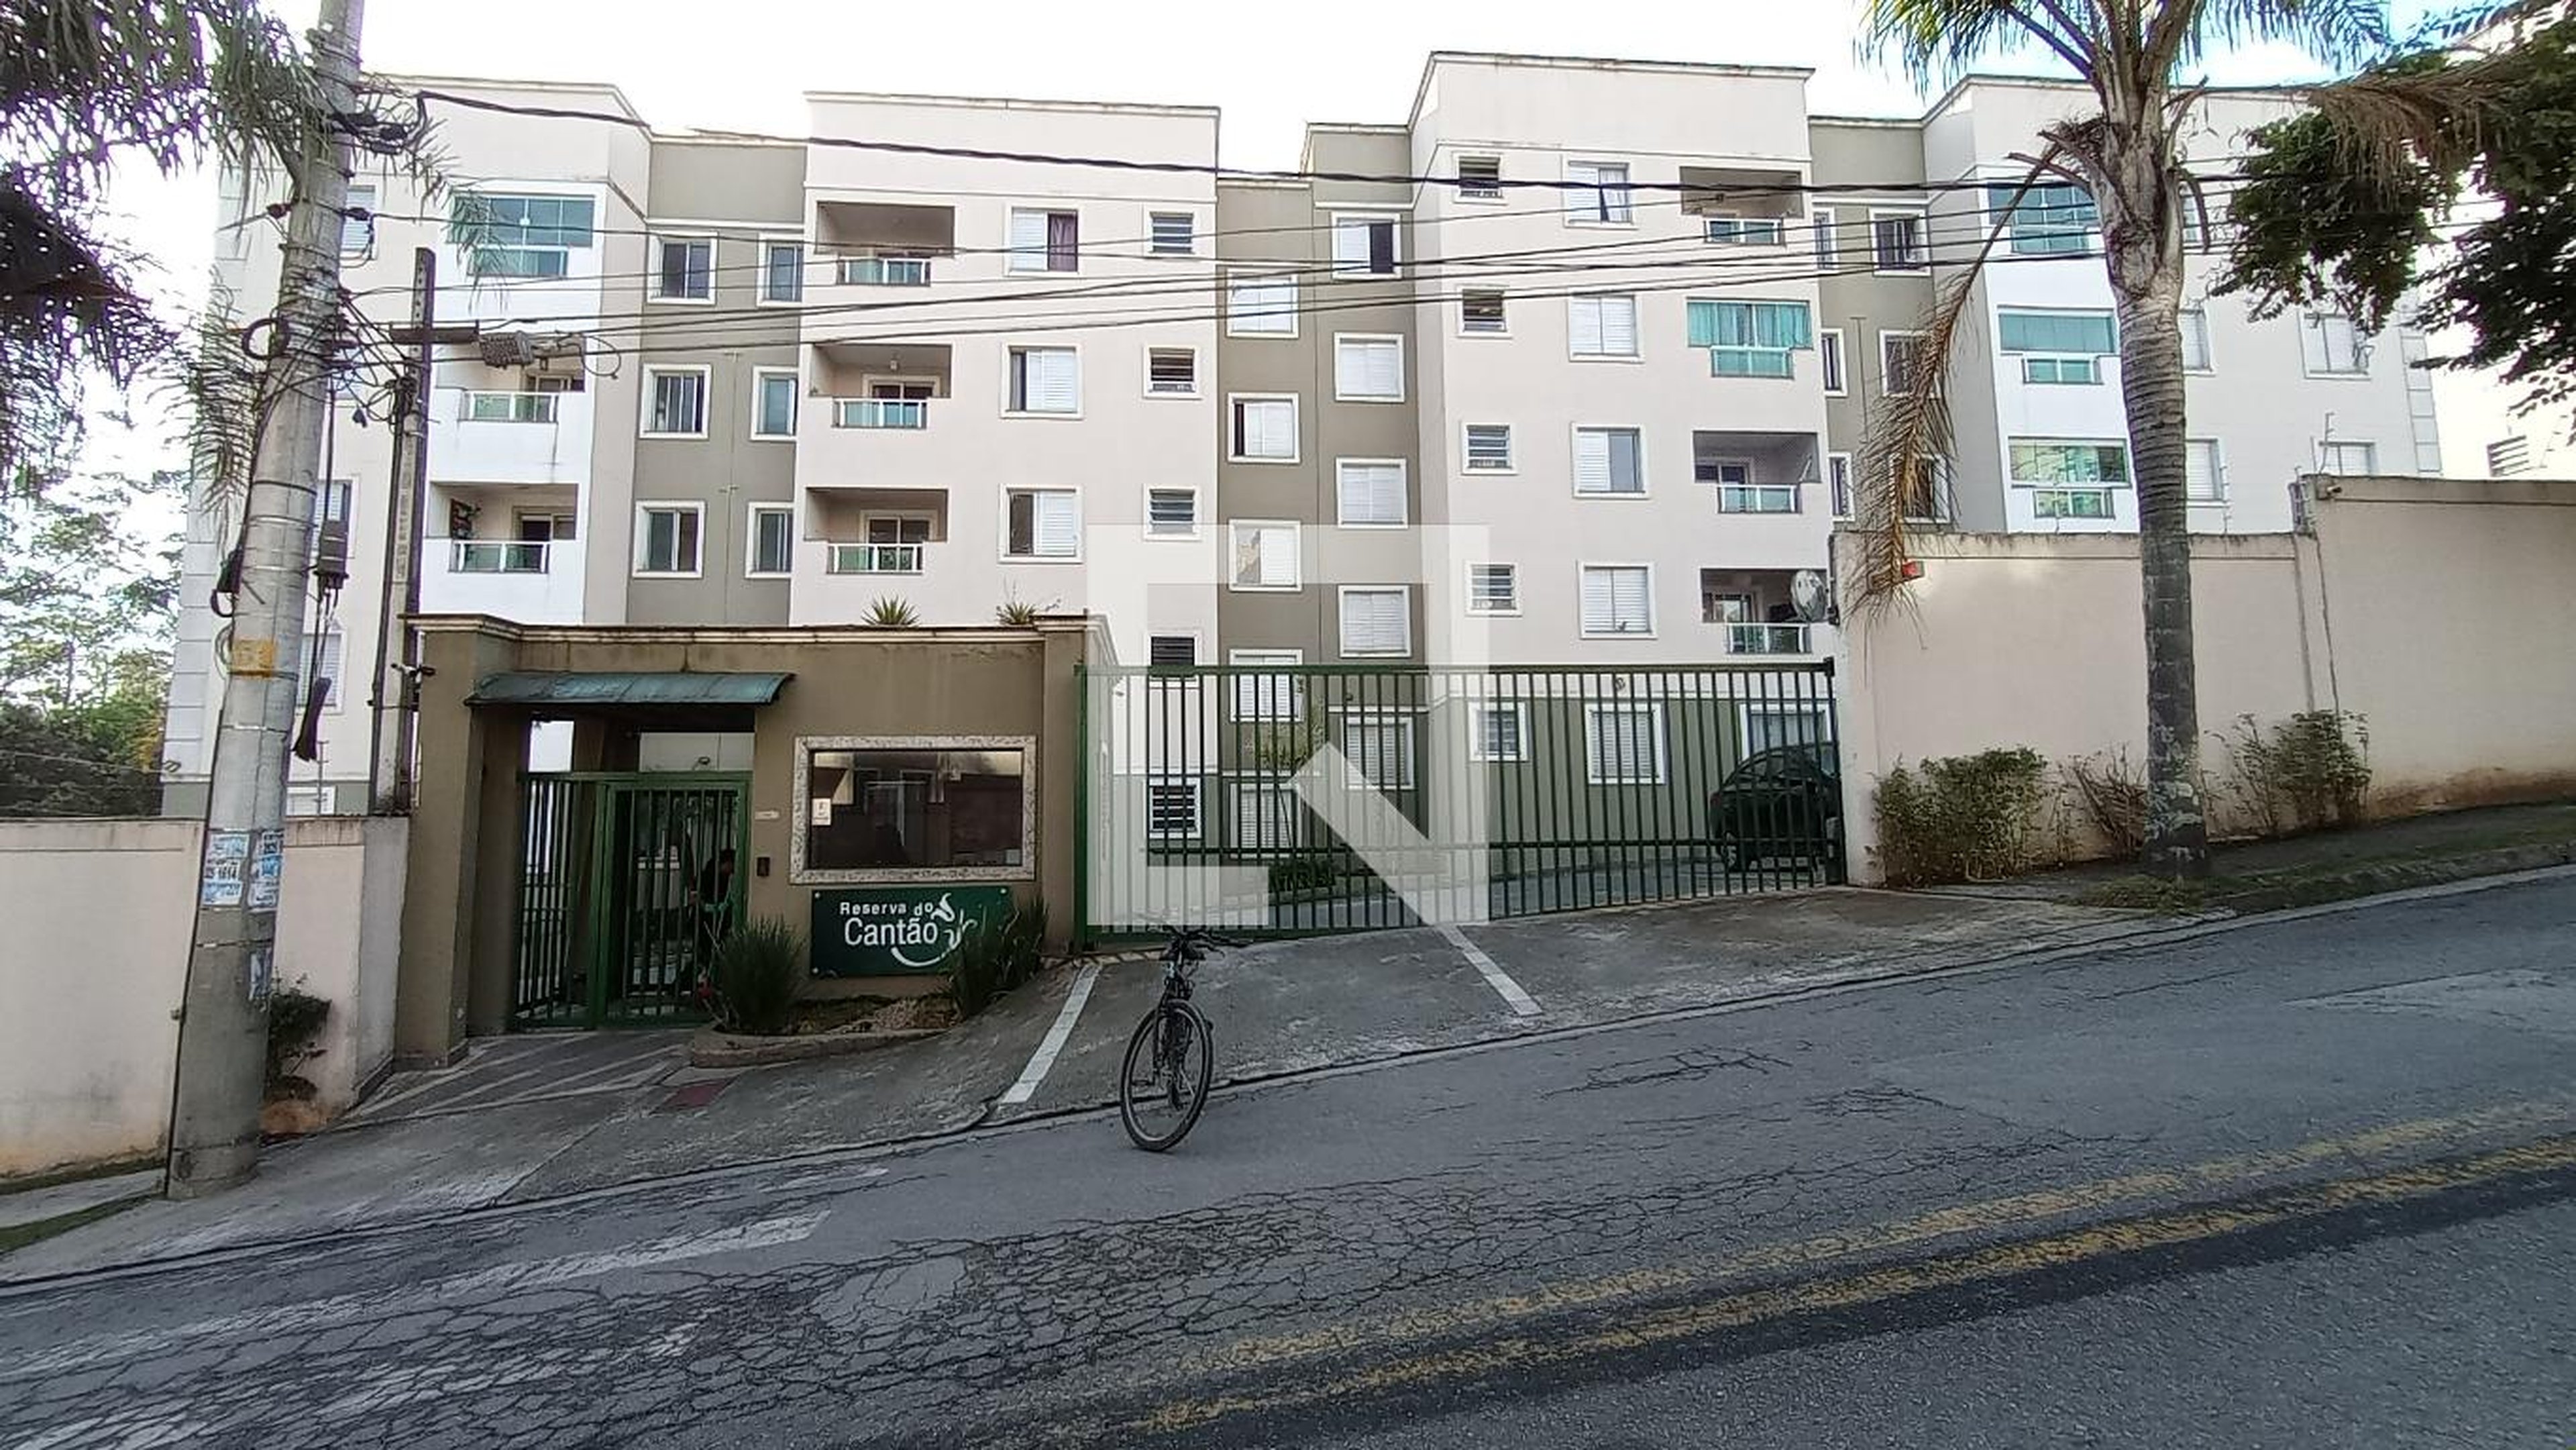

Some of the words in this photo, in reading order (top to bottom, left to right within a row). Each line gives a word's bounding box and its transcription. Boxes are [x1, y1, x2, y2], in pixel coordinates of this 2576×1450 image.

[840, 902, 906, 915] Reserva
[914, 902, 934, 916] do
[845, 917, 938, 946] Cantão
